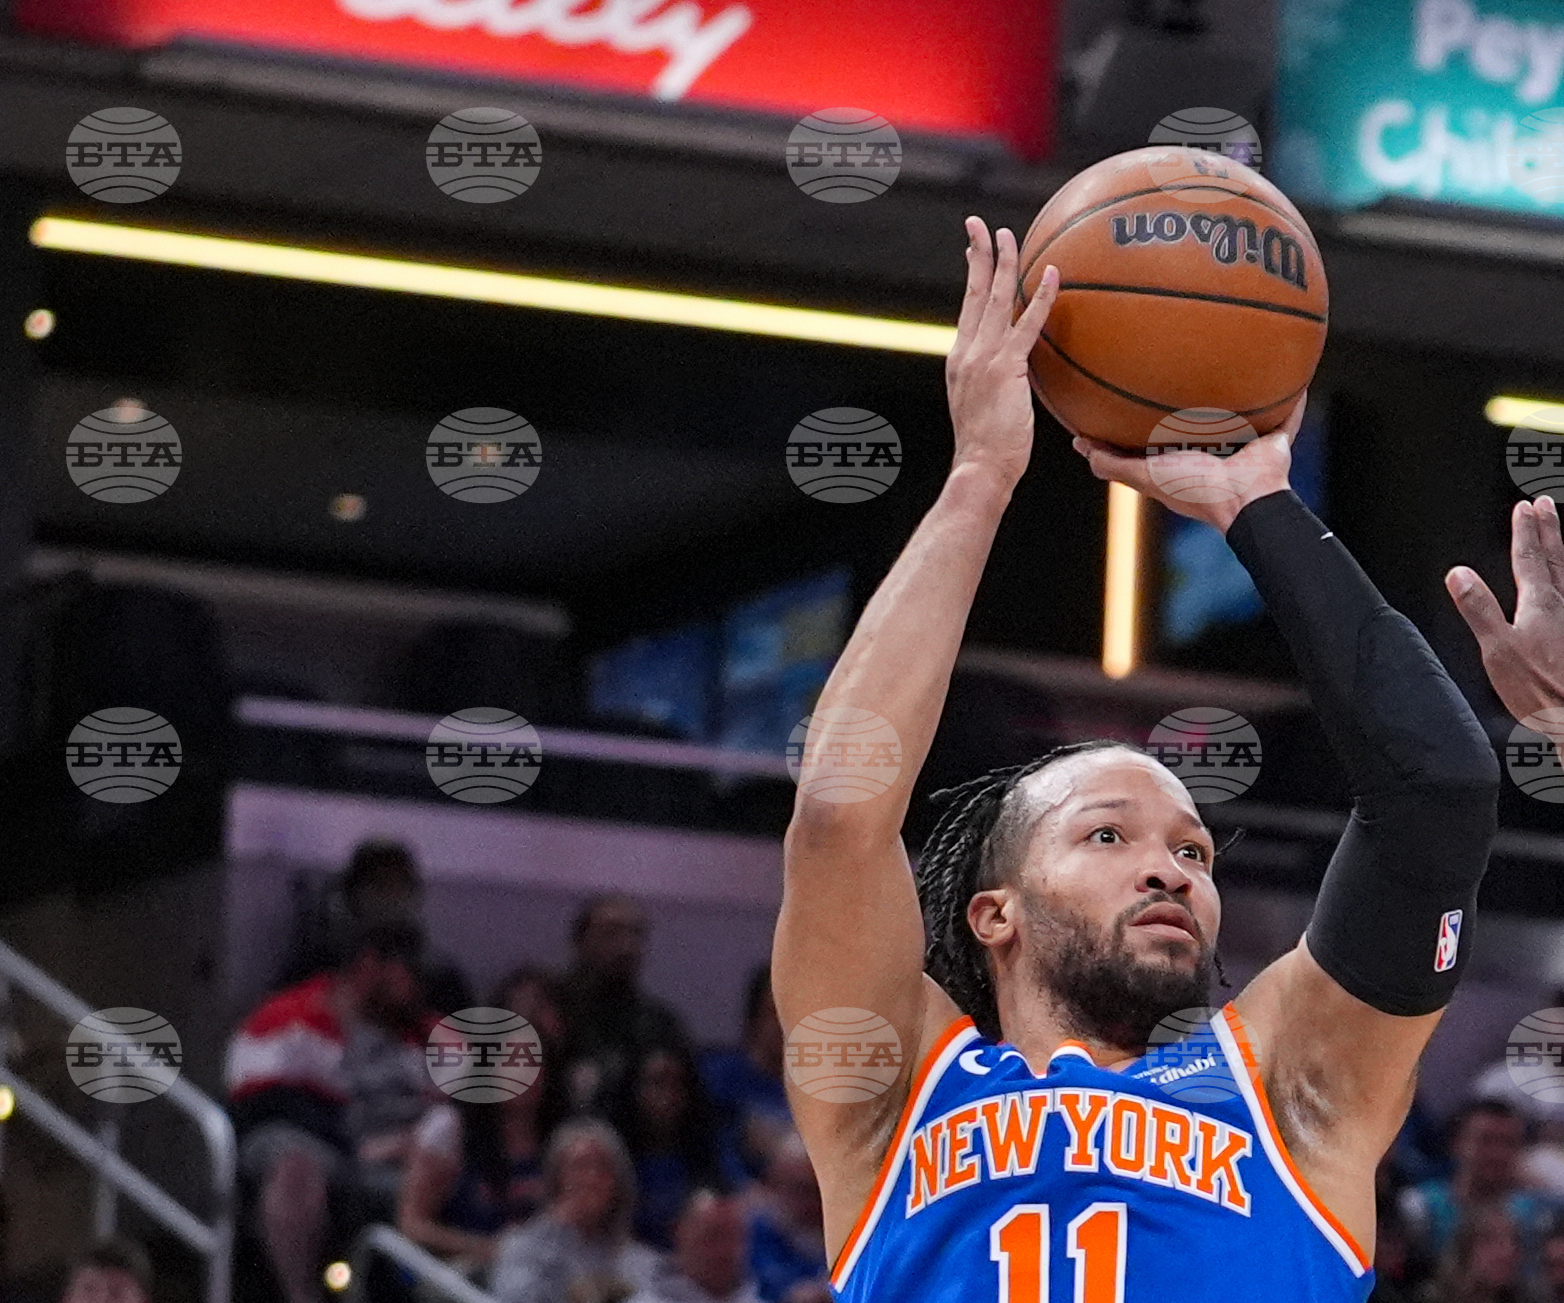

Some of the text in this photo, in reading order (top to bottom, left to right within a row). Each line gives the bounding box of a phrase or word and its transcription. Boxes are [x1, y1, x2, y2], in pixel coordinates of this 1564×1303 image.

[1111, 211, 1308, 292] Wilson
[905, 1086, 1253, 1220] NEW YORK
